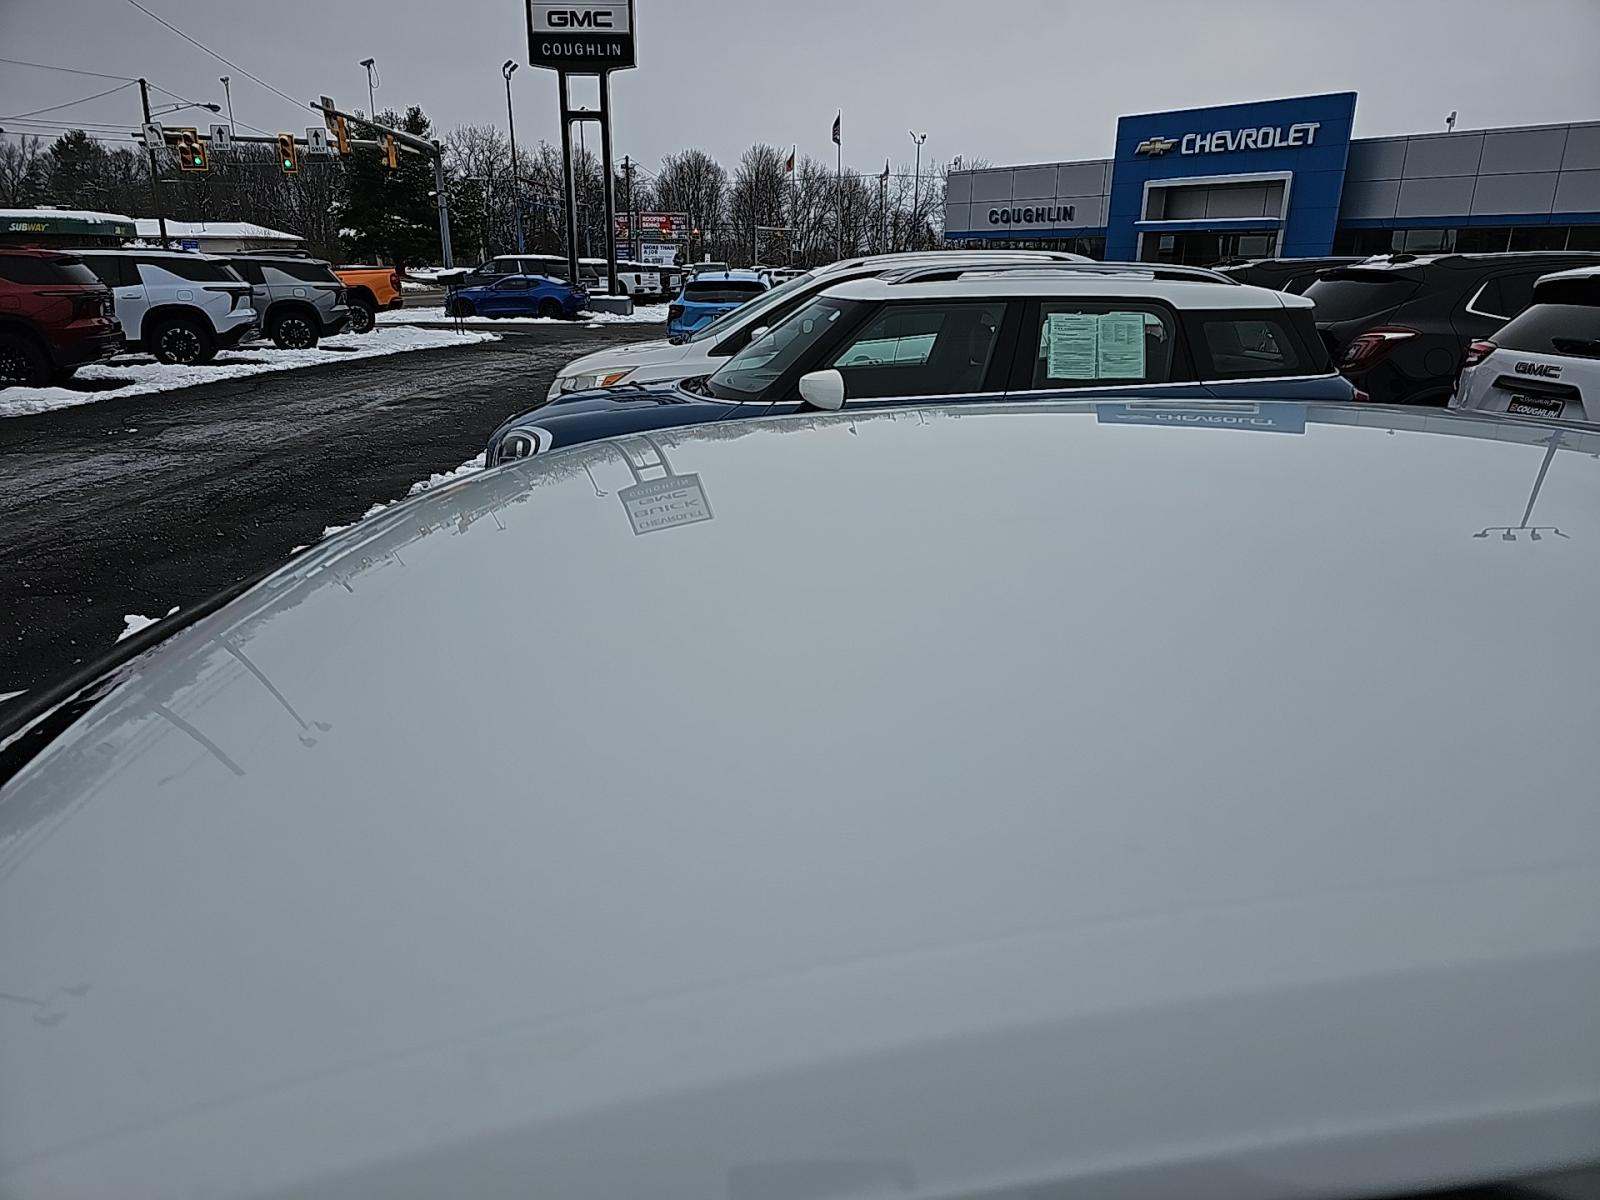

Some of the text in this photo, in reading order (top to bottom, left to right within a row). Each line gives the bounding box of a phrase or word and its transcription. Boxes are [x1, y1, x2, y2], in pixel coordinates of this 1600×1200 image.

[546, 10, 613, 28] GMC
[541, 42, 621, 56] COUGHLIN
[1180, 122, 1321, 155] CHEVROLET
[988, 205, 1076, 224] COUGHLIN
[8, 222, 46, 232] SUBWAY
[1514, 361, 1563, 379] GMC
[1516, 405, 1559, 417] COUGHLIN
